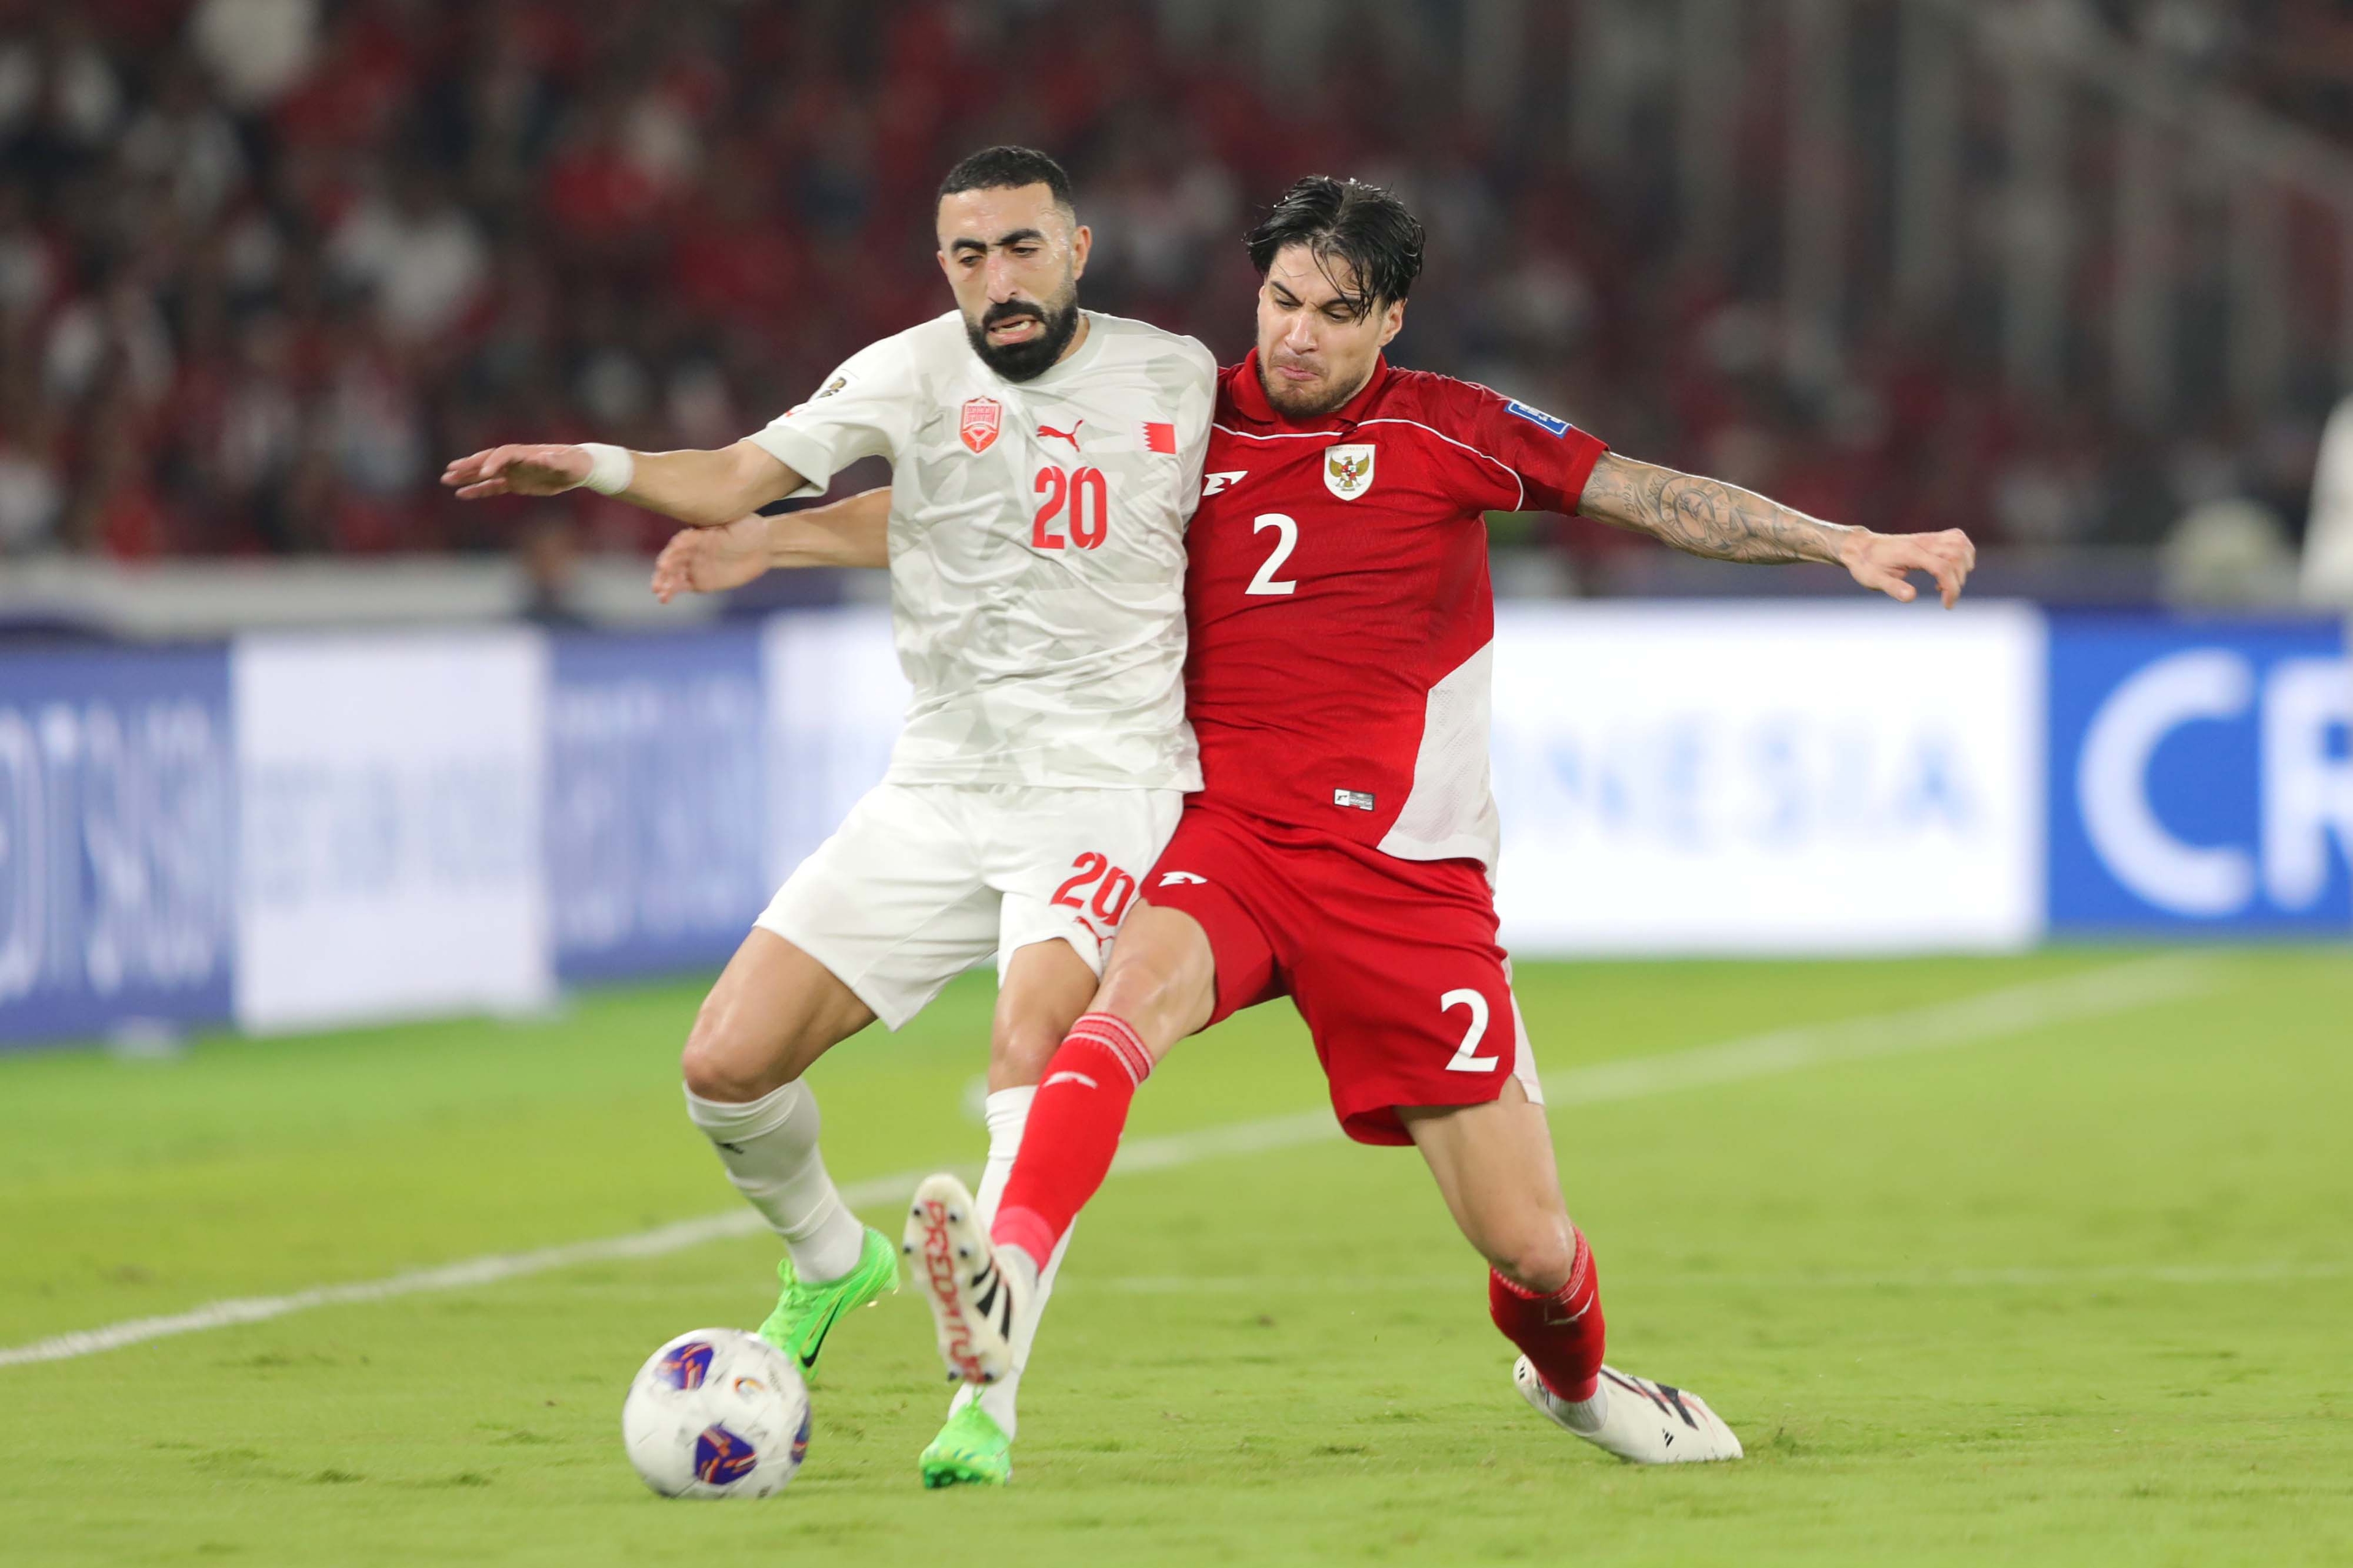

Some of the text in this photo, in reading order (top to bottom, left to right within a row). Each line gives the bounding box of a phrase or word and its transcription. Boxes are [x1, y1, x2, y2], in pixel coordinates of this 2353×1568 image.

[1032, 466, 1108, 550] 20
[1245, 513, 1298, 595] 2
[1049, 852, 1135, 926] 20
[1441, 988, 1499, 1072] 2
